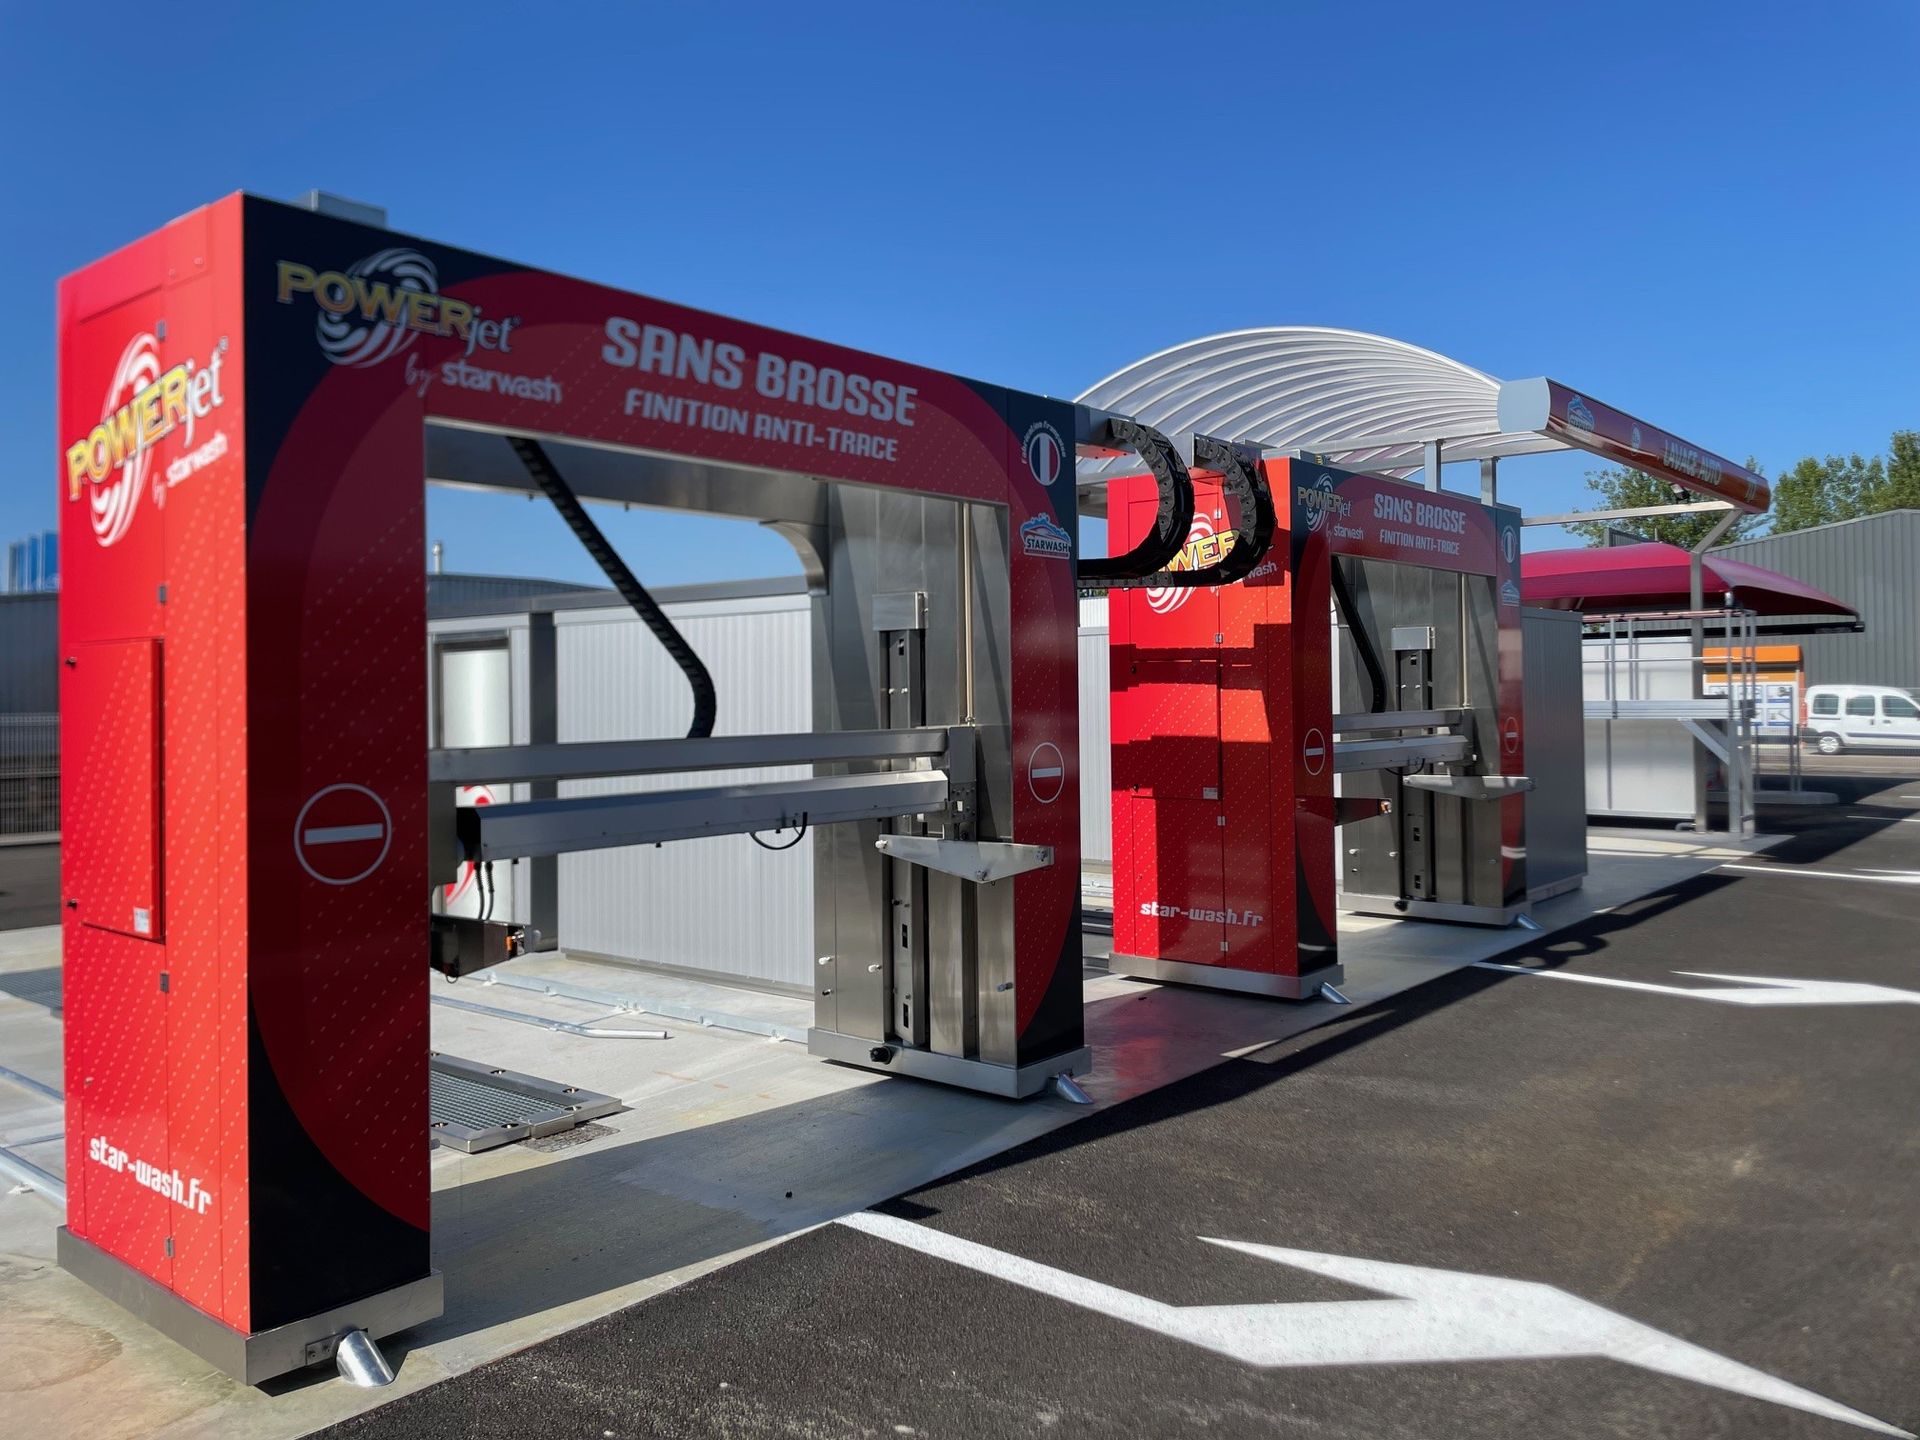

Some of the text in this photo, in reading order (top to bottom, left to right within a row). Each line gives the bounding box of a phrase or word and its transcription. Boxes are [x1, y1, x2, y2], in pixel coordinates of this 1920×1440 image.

[404, 352, 562, 404] by starwash
[602, 316, 918, 426] SANS BROSSE
[624, 387, 898, 462] FINITION ANTI-TRACE
[1373, 493, 1466, 534] SANS BROSSE
[1026, 538, 1068, 553] STARWASH
[1379, 528, 1460, 556] FINITION ANTI-TRACE
[1139, 901, 1264, 928] star-wash.fr
[89, 1135, 212, 1215] star-wash.fr
